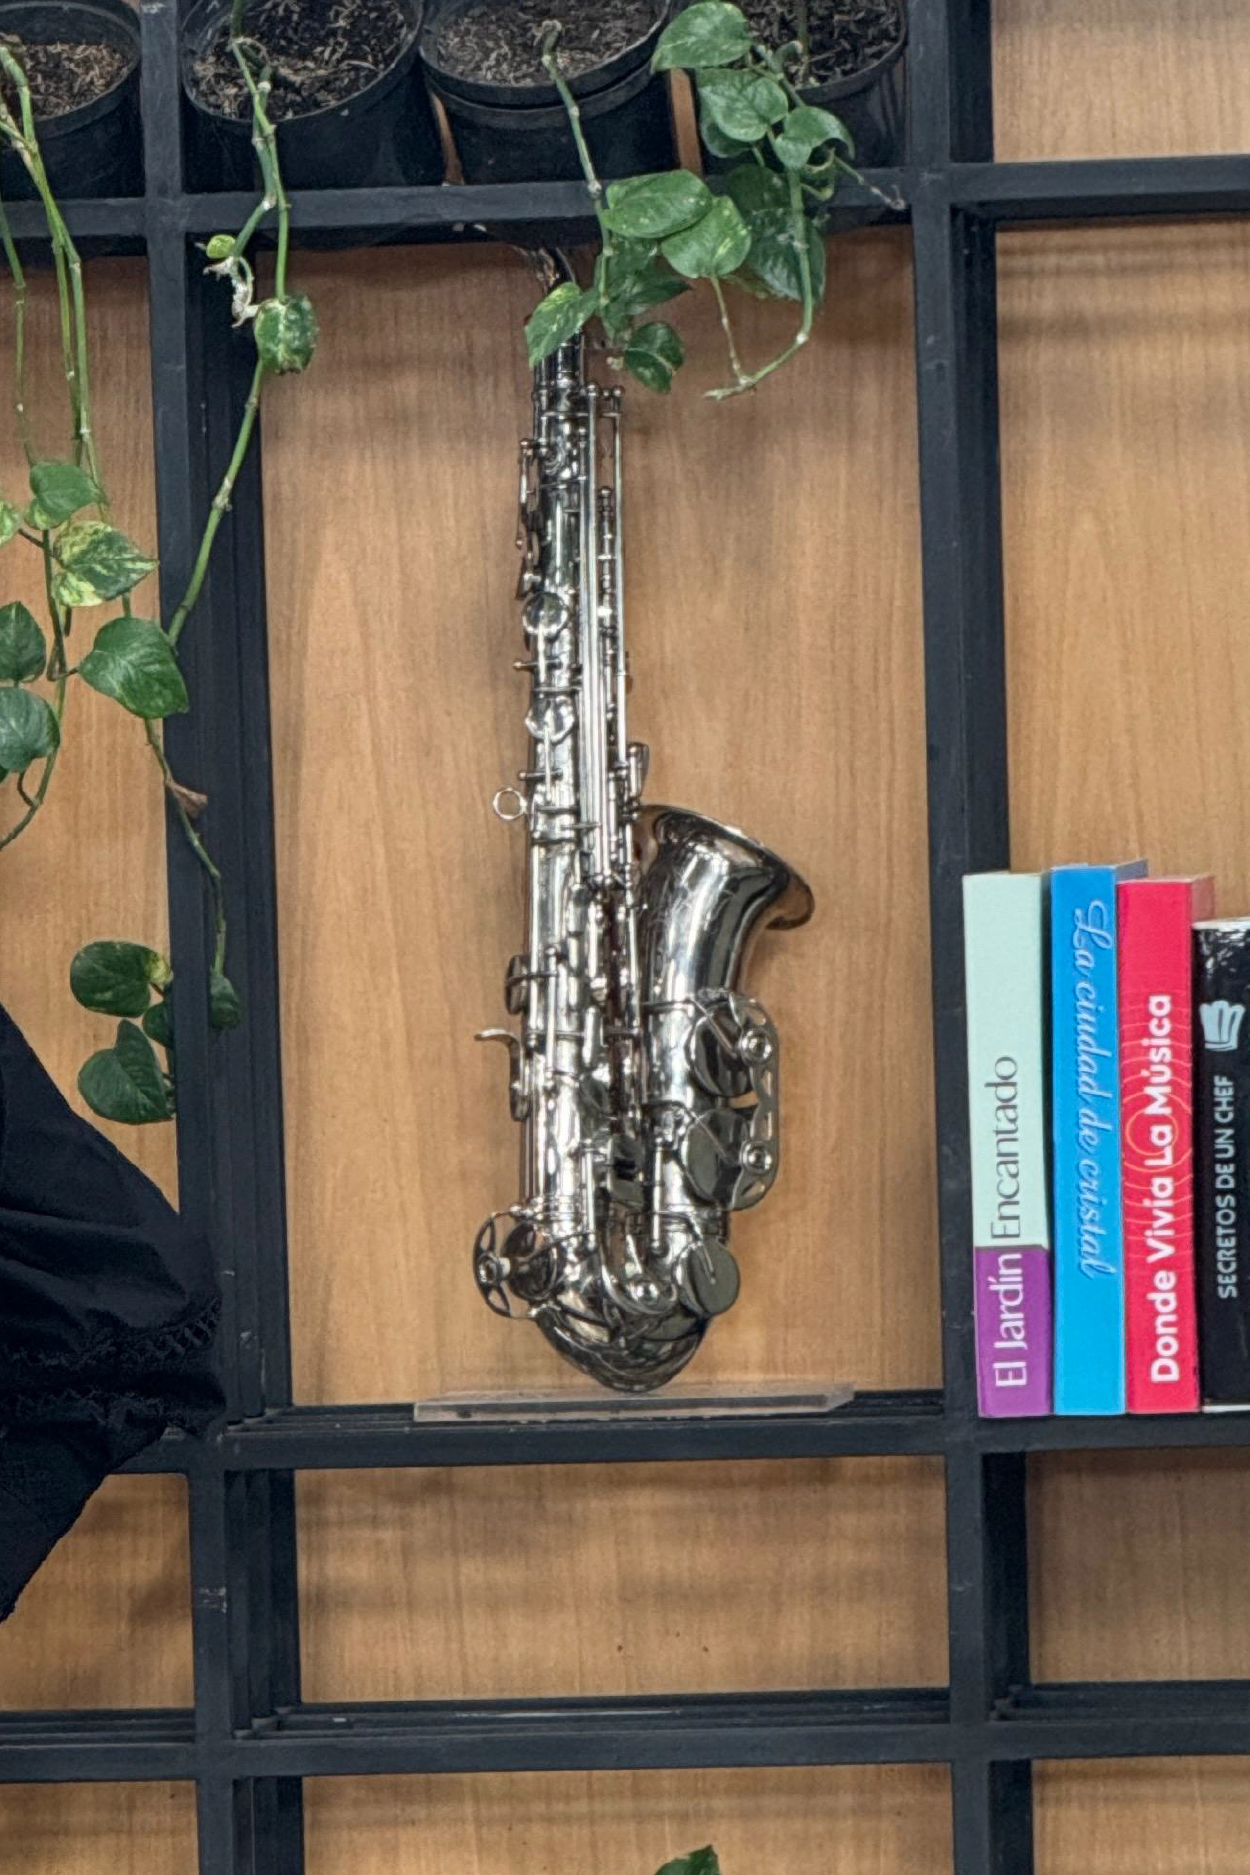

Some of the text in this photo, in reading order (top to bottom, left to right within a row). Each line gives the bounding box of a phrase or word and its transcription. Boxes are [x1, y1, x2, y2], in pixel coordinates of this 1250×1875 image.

[1073, 900, 1117, 1279] La ciudad de cristal
[1140, 995, 1173, 1115] Música
[984, 1056, 1028, 1387] El Jardín Encantado
[1144, 1124, 1173, 1167] La
[1213, 1075, 1238, 1299] SECRETOS DE UN CHEF
[1147, 1269, 1180, 1383] Donde
